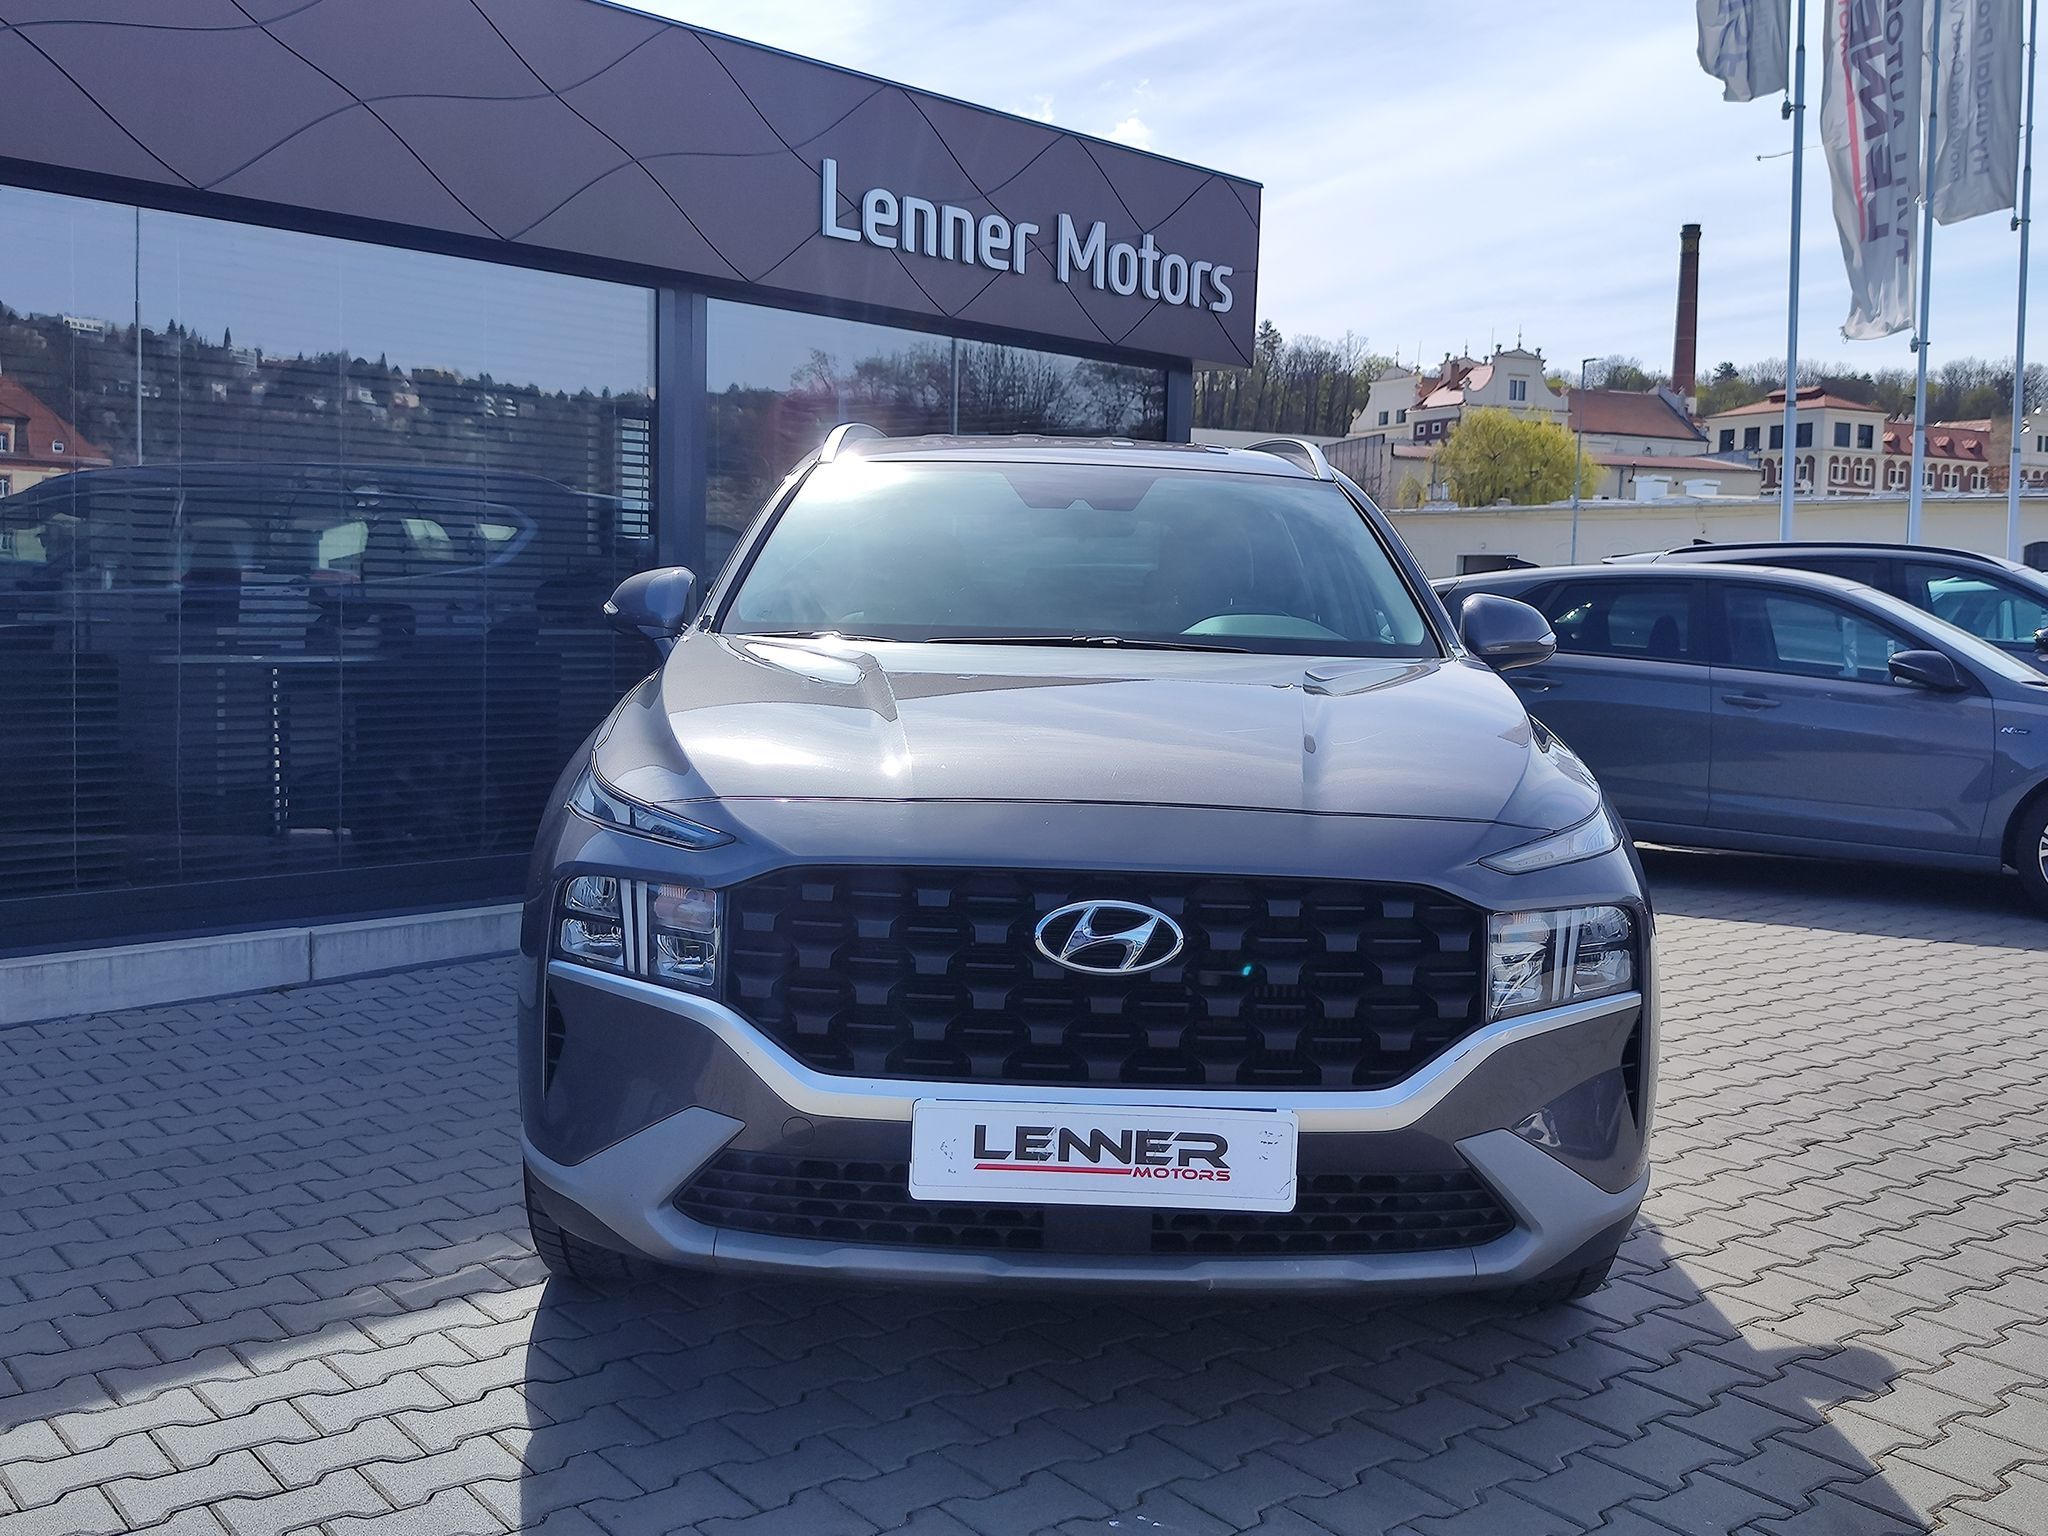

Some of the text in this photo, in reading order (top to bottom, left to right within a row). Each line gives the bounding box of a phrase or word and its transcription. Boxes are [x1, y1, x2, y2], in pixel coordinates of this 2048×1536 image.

[821, 157, 1234, 314] Lenner Motors
[973, 1123, 1231, 1169] LENNER
[1131, 1165, 1232, 1183] MOTORS
